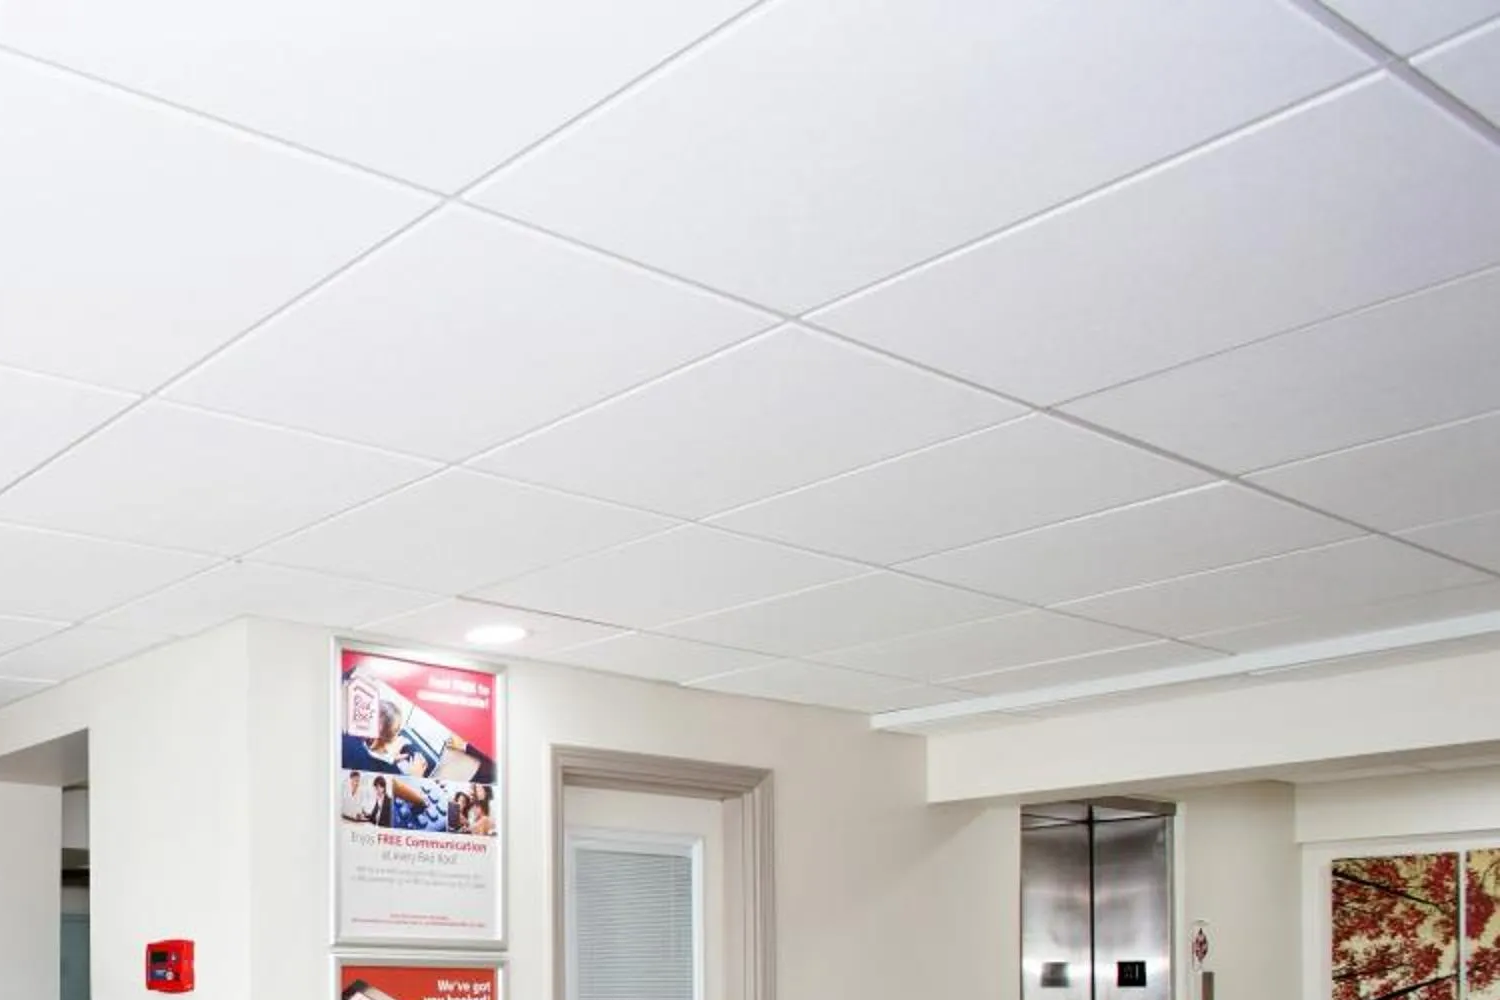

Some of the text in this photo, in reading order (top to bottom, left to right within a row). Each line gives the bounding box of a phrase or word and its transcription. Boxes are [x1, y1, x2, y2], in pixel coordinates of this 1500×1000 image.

[377, 832, 402, 847] FREE
[405, 835, 487, 854] Communication
[436, 979, 491, 995] We've got
